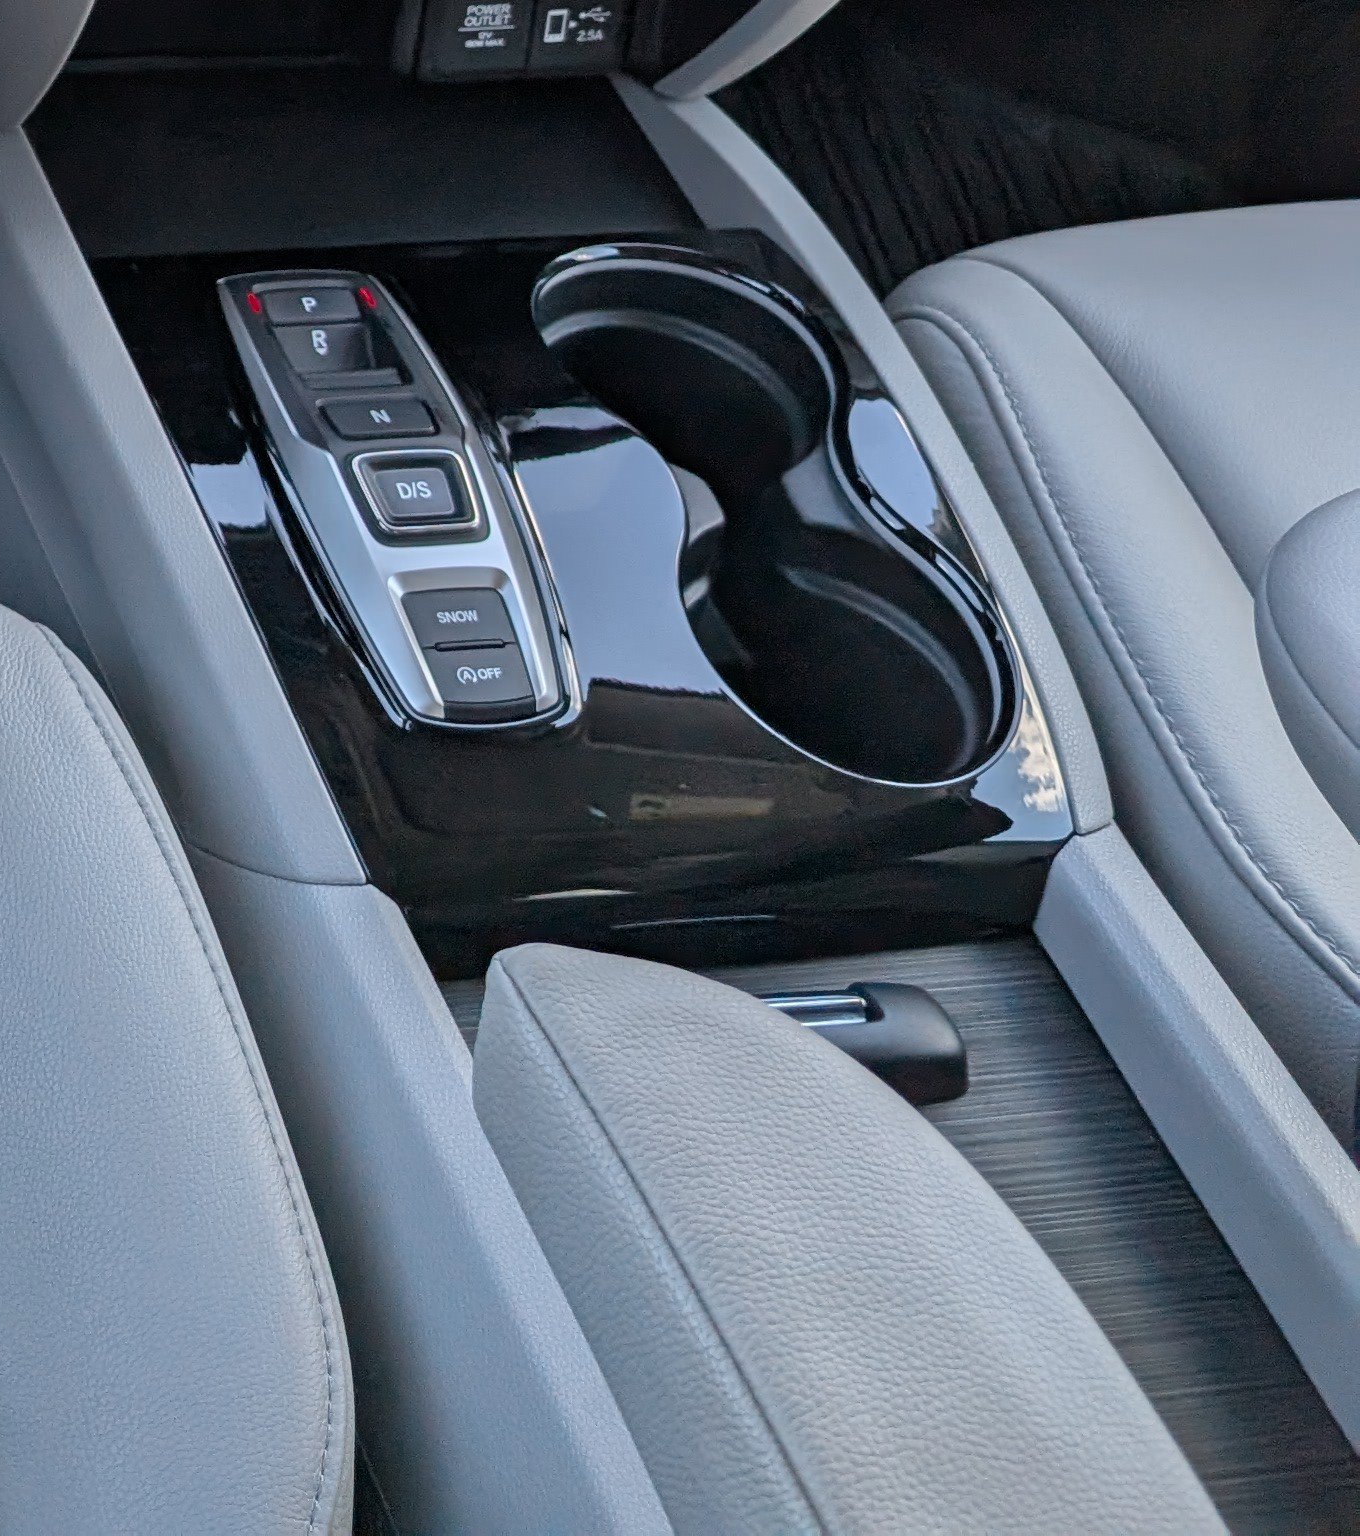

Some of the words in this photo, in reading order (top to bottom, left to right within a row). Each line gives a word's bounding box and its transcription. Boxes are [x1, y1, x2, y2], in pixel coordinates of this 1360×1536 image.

[467, 3, 512, 15] POWER
[464, 15, 511, 27] OUTLET
[302, 297, 316, 312] P
[312, 330, 327, 347] R
[371, 409, 391, 423] N
[398, 481, 431, 499] D/S
[437, 611, 478, 624] SNOW
[478, 667, 502, 680] OFF
